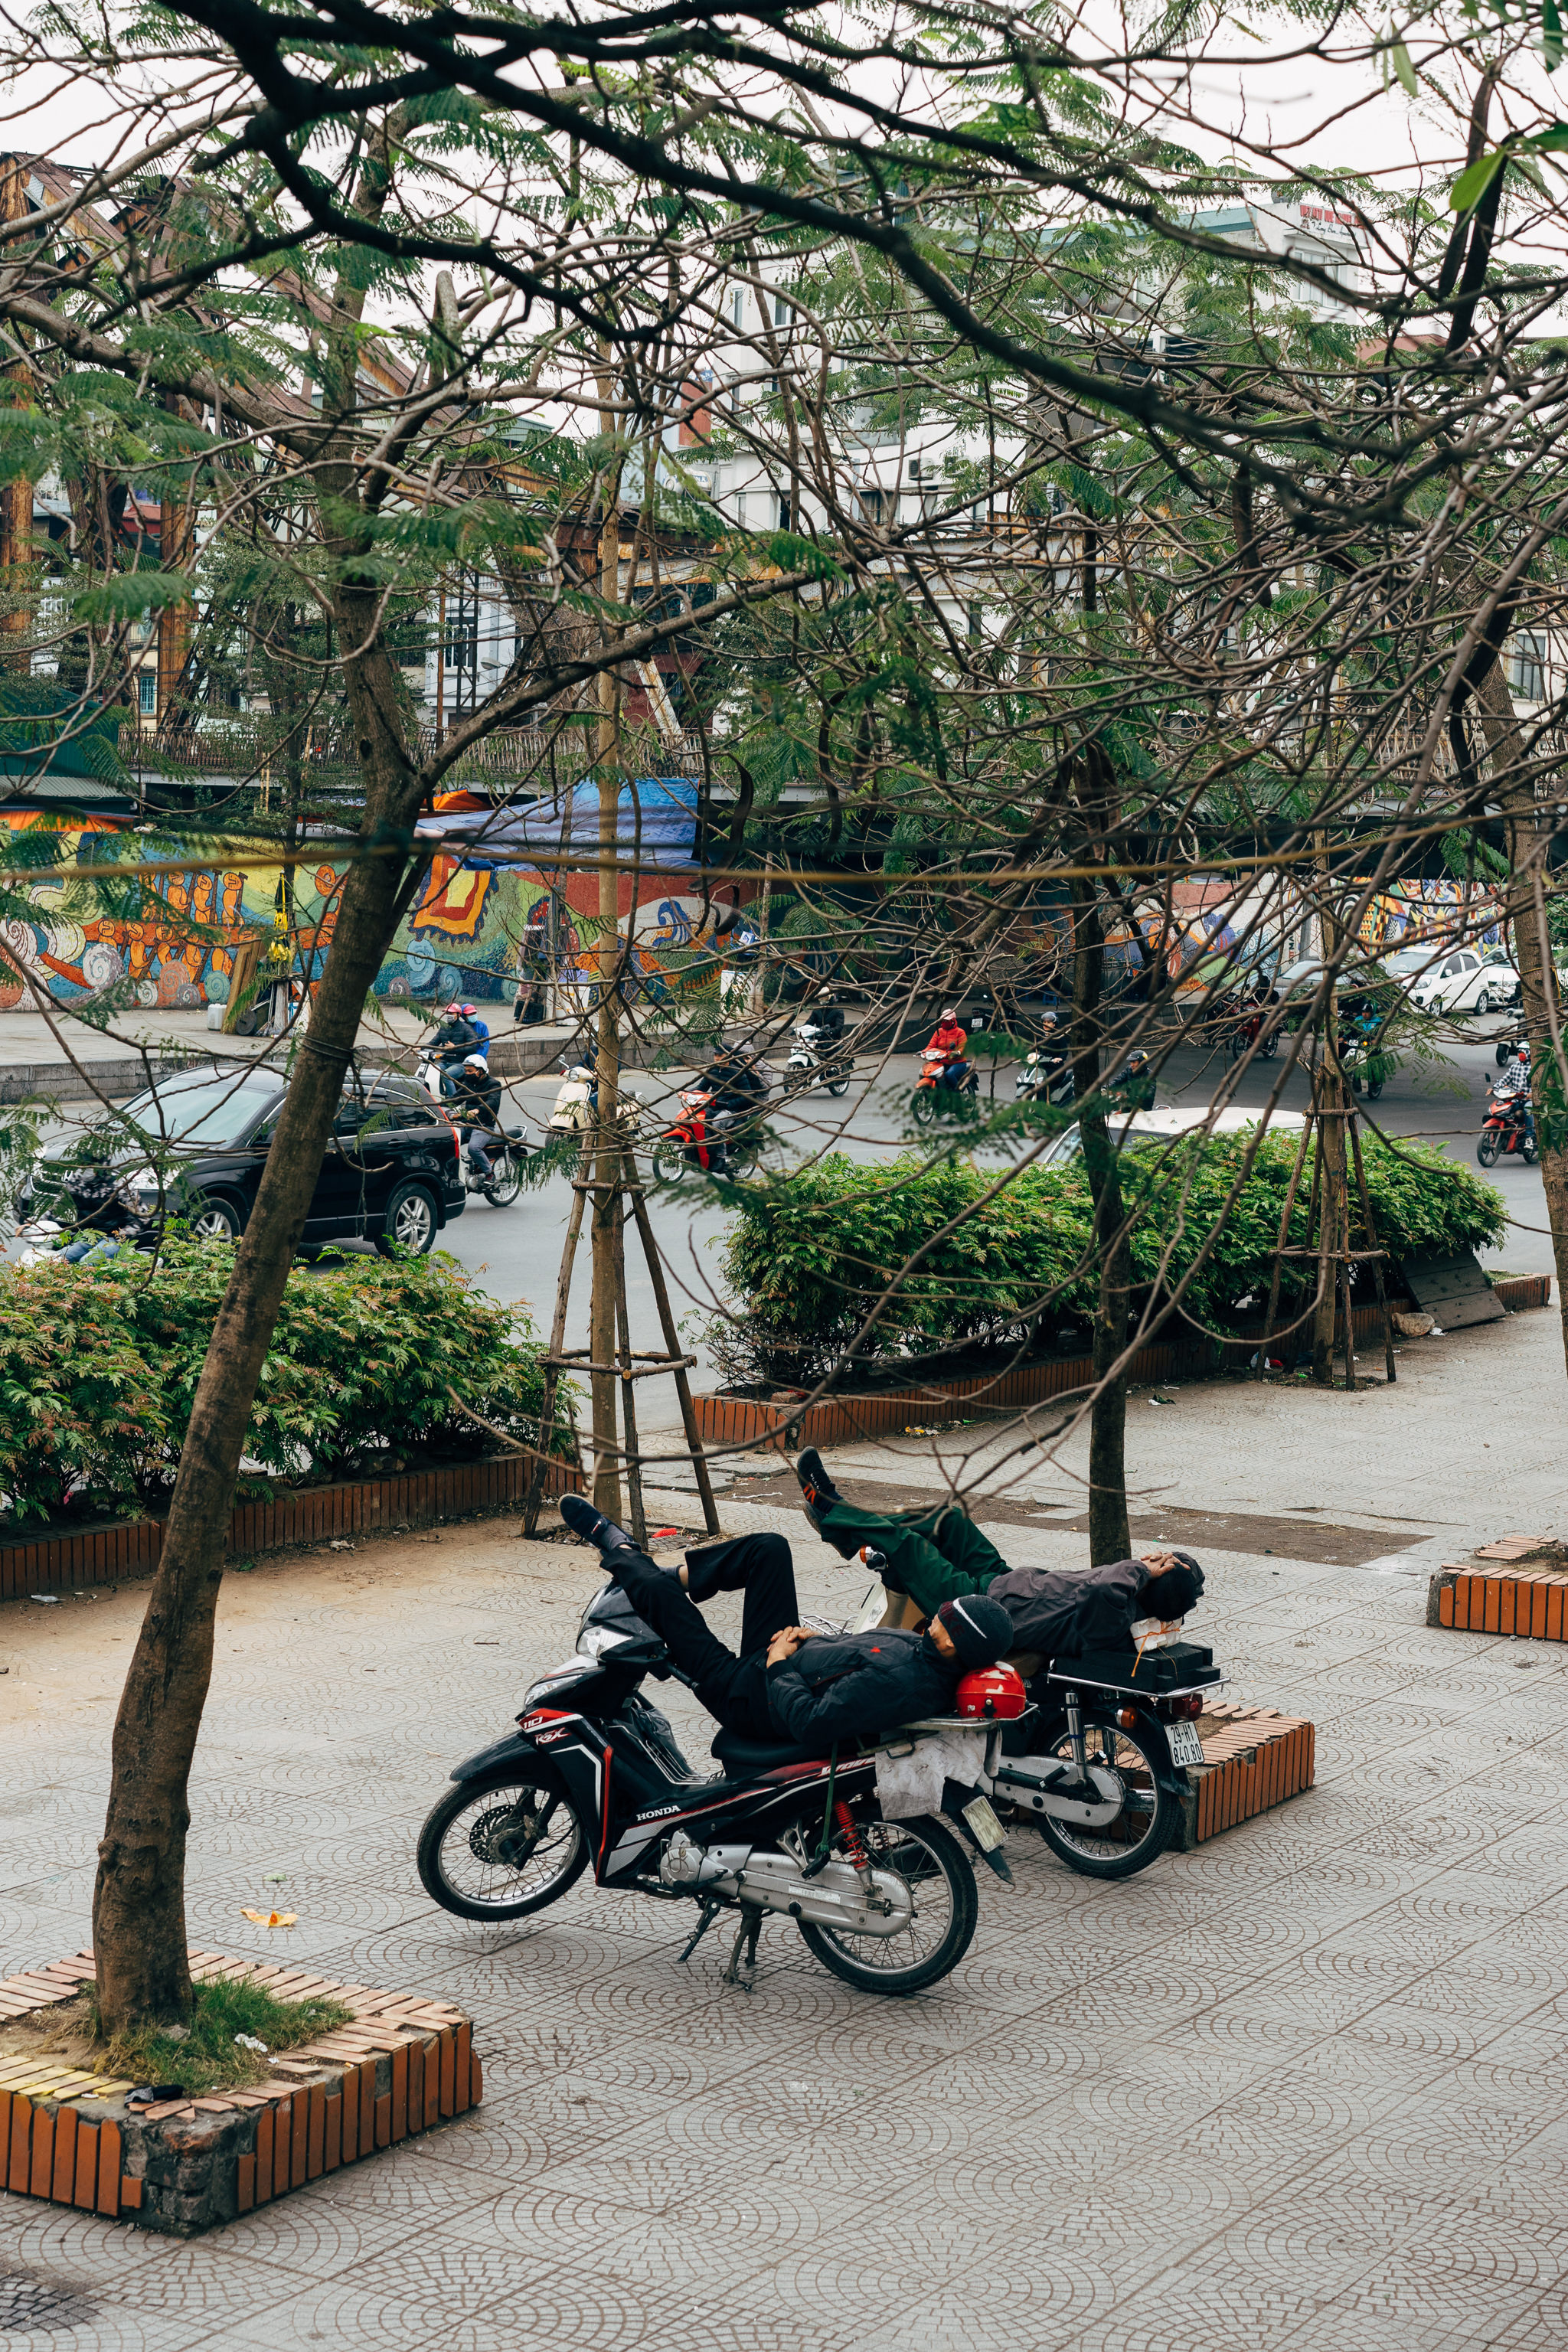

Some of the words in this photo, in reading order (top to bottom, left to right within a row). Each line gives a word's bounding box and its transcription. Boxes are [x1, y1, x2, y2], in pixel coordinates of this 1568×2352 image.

[523, 1716, 544, 1729] 110
[1171, 1723, 1194, 1744] 29-H1
[1173, 1743, 1202, 1765] 840.80
[636, 1805, 681, 1821] HONDA
